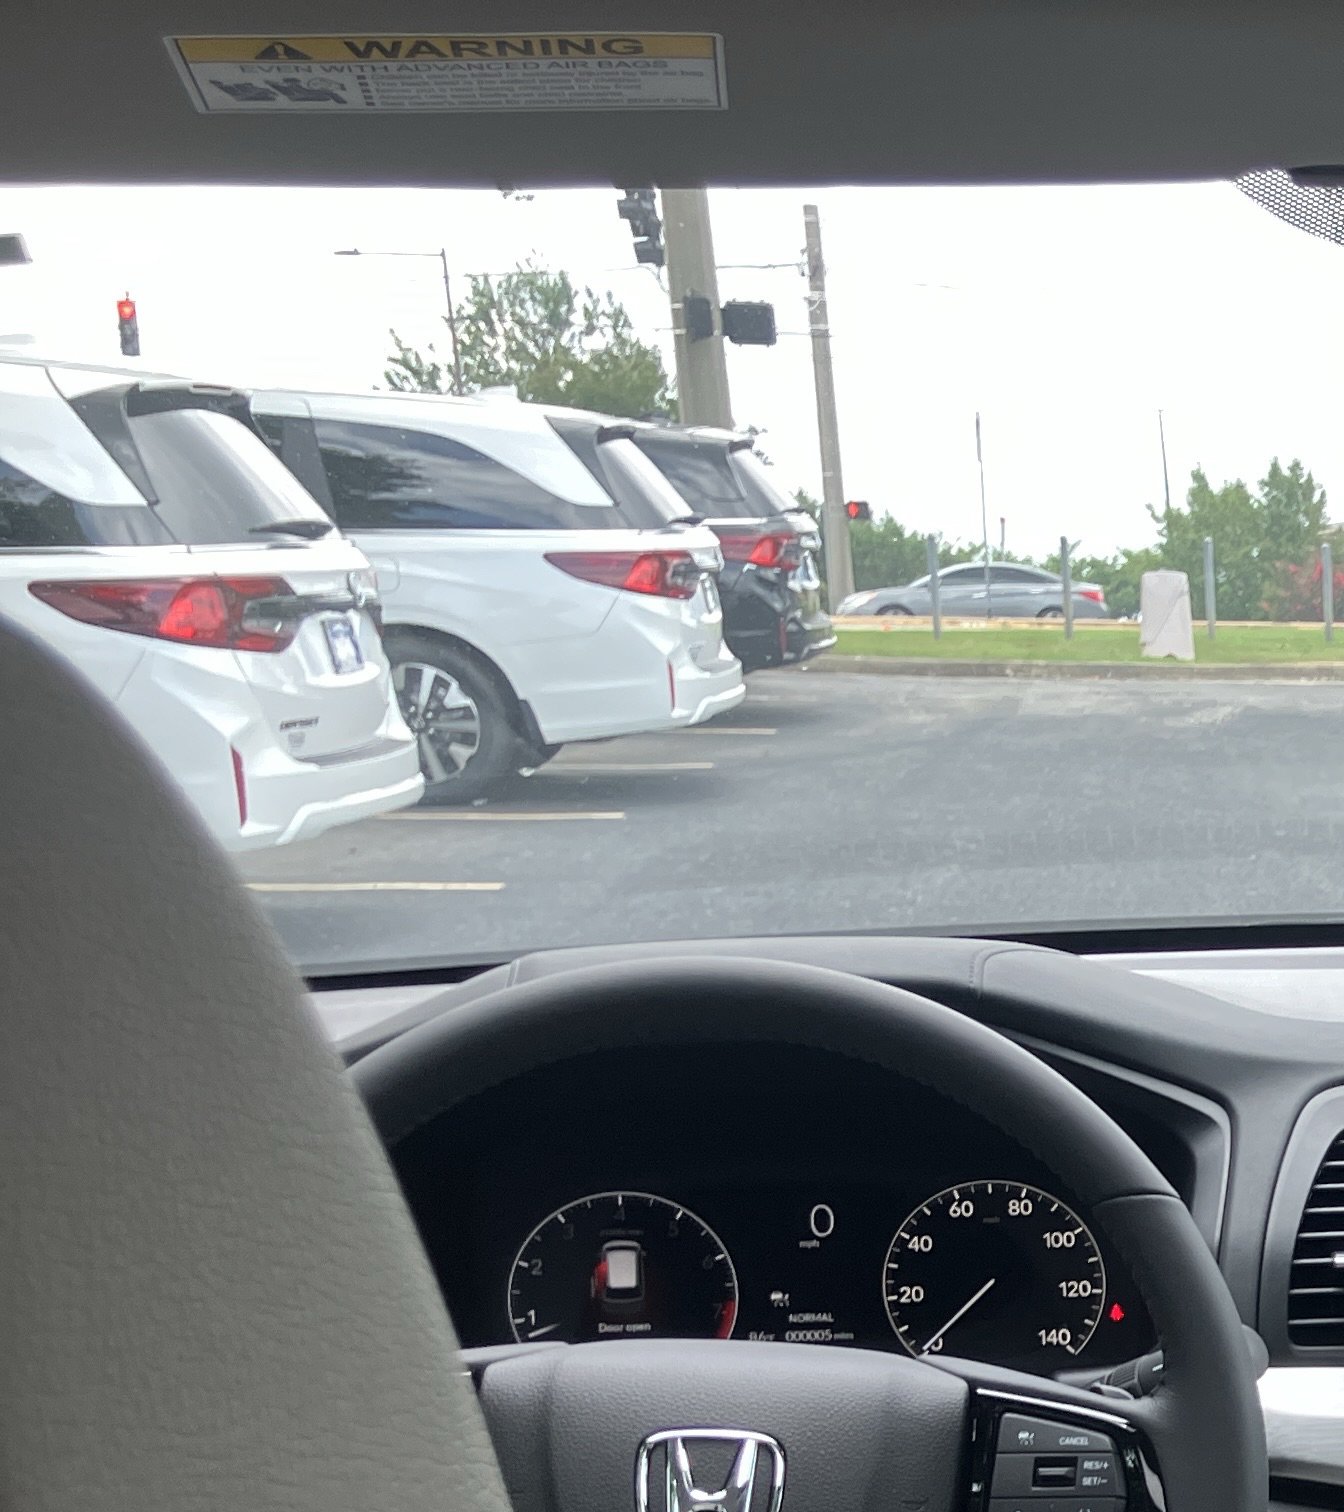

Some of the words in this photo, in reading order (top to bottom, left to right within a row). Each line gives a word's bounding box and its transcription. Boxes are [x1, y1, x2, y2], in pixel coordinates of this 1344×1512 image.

[343, 38, 645, 59] WARNING
[240, 64, 313, 74] EVEN
[320, 63, 390, 73] WITH
[396, 61, 541, 73] ADVANCED
[546, 60, 591, 70] AIR
[598, 60, 670, 69] BAGS
[948, 1200, 974, 1218] 60
[1007, 1198, 1033, 1217] 80
[810, 1203, 835, 1238] 0
[906, 1234, 933, 1253] 40
[1042, 1231, 1076, 1249] 100
[530, 1258, 542, 1276] 2
[899, 1285, 925, 1304] 20
[1058, 1279, 1092, 1298] 120
[527, 1308, 536, 1326] 1
[788, 1312, 835, 1323] NORMAL
[598, 1321, 624, 1333] Door
[1038, 1327, 1072, 1347] 140
[1058, 1436, 1090, 1446] CANCEL
[1082, 1460, 1110, 1471] RES/+
